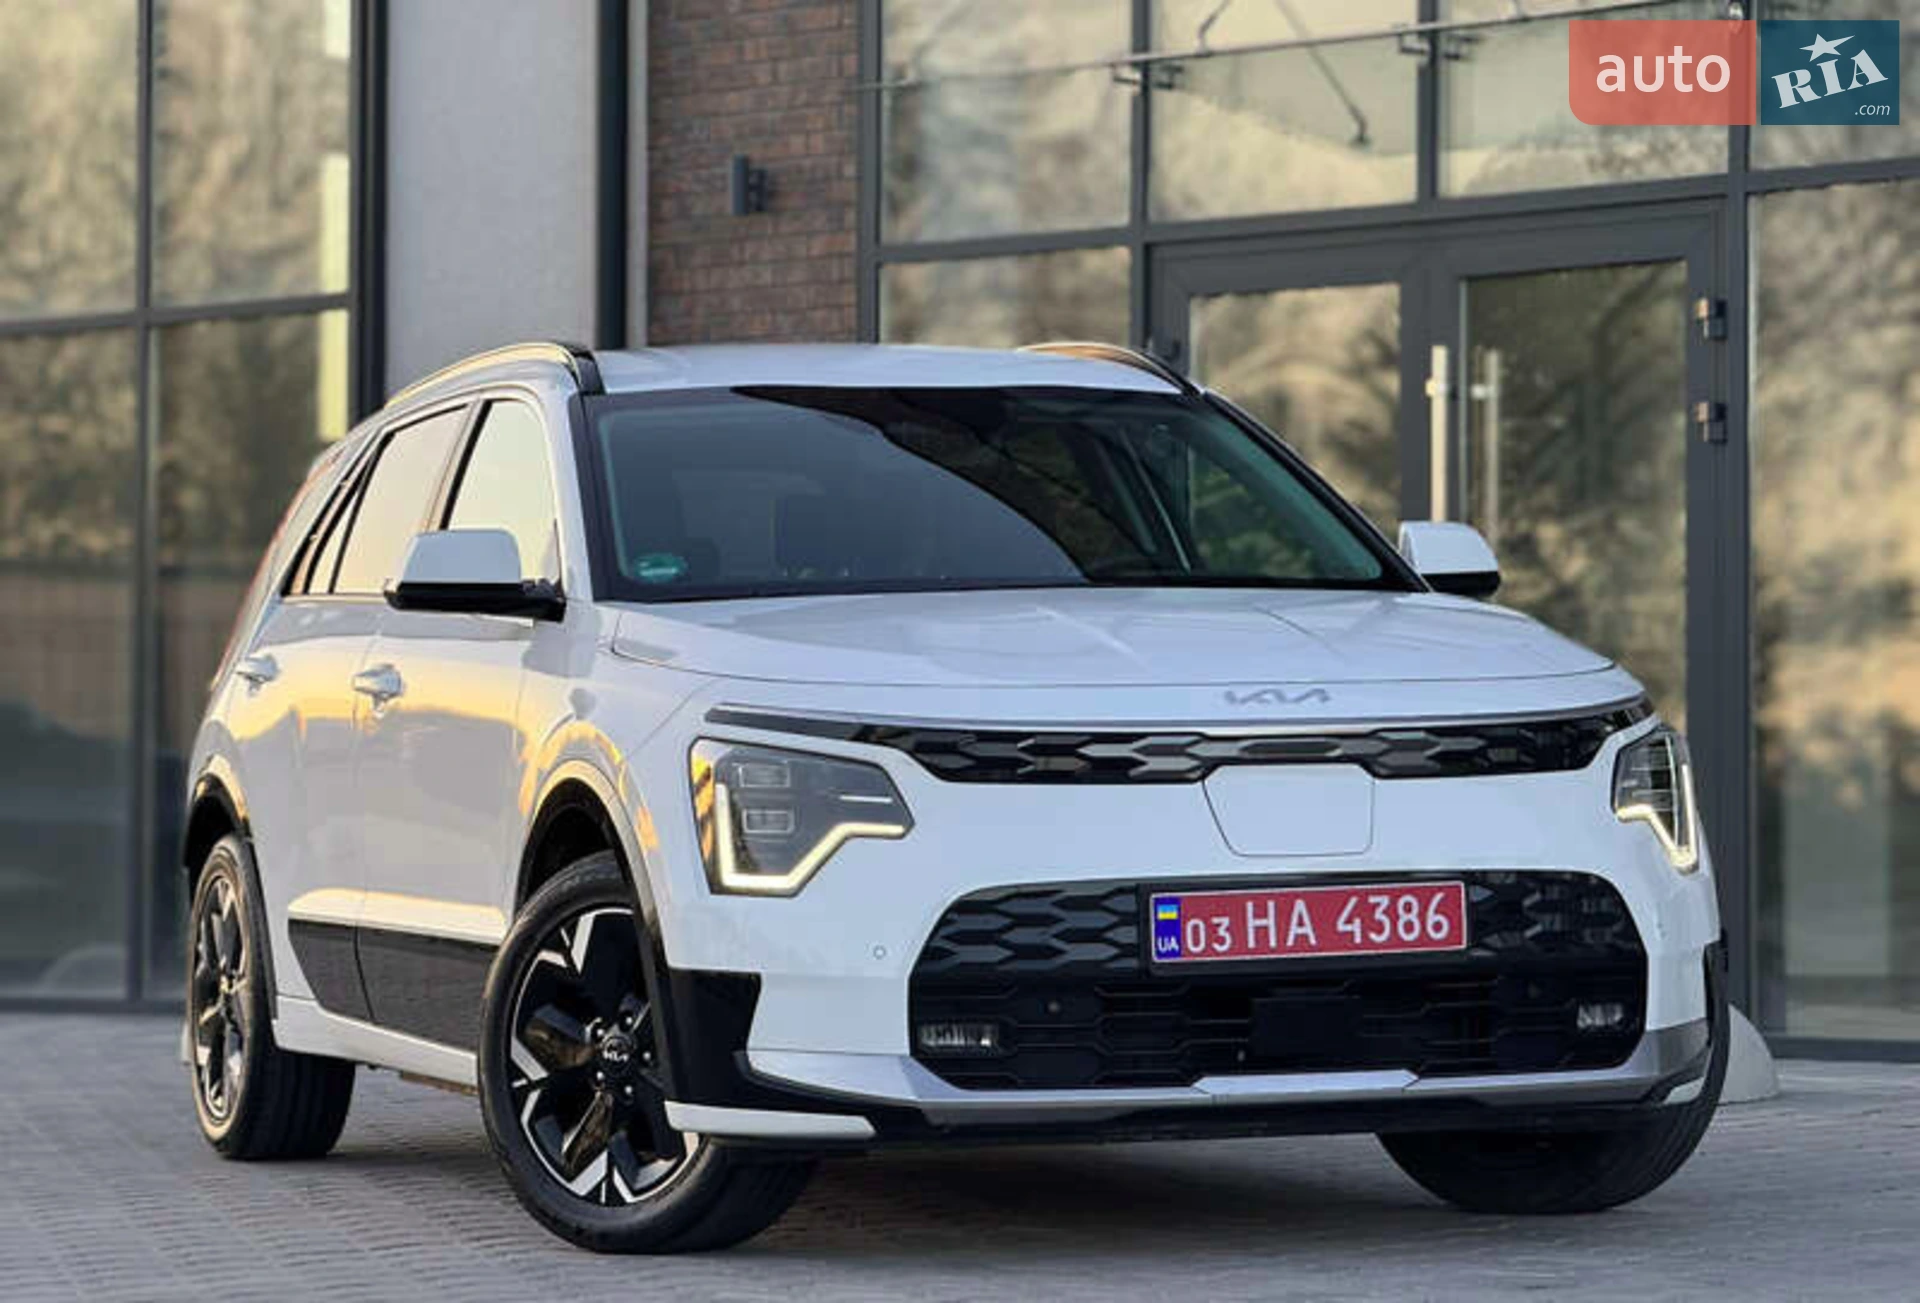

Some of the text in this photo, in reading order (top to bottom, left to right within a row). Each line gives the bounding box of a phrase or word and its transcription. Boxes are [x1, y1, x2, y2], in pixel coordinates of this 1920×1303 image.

[1185, 892, 1451, 953] 03 HA 4386
[1157, 937, 1179, 953] UA
